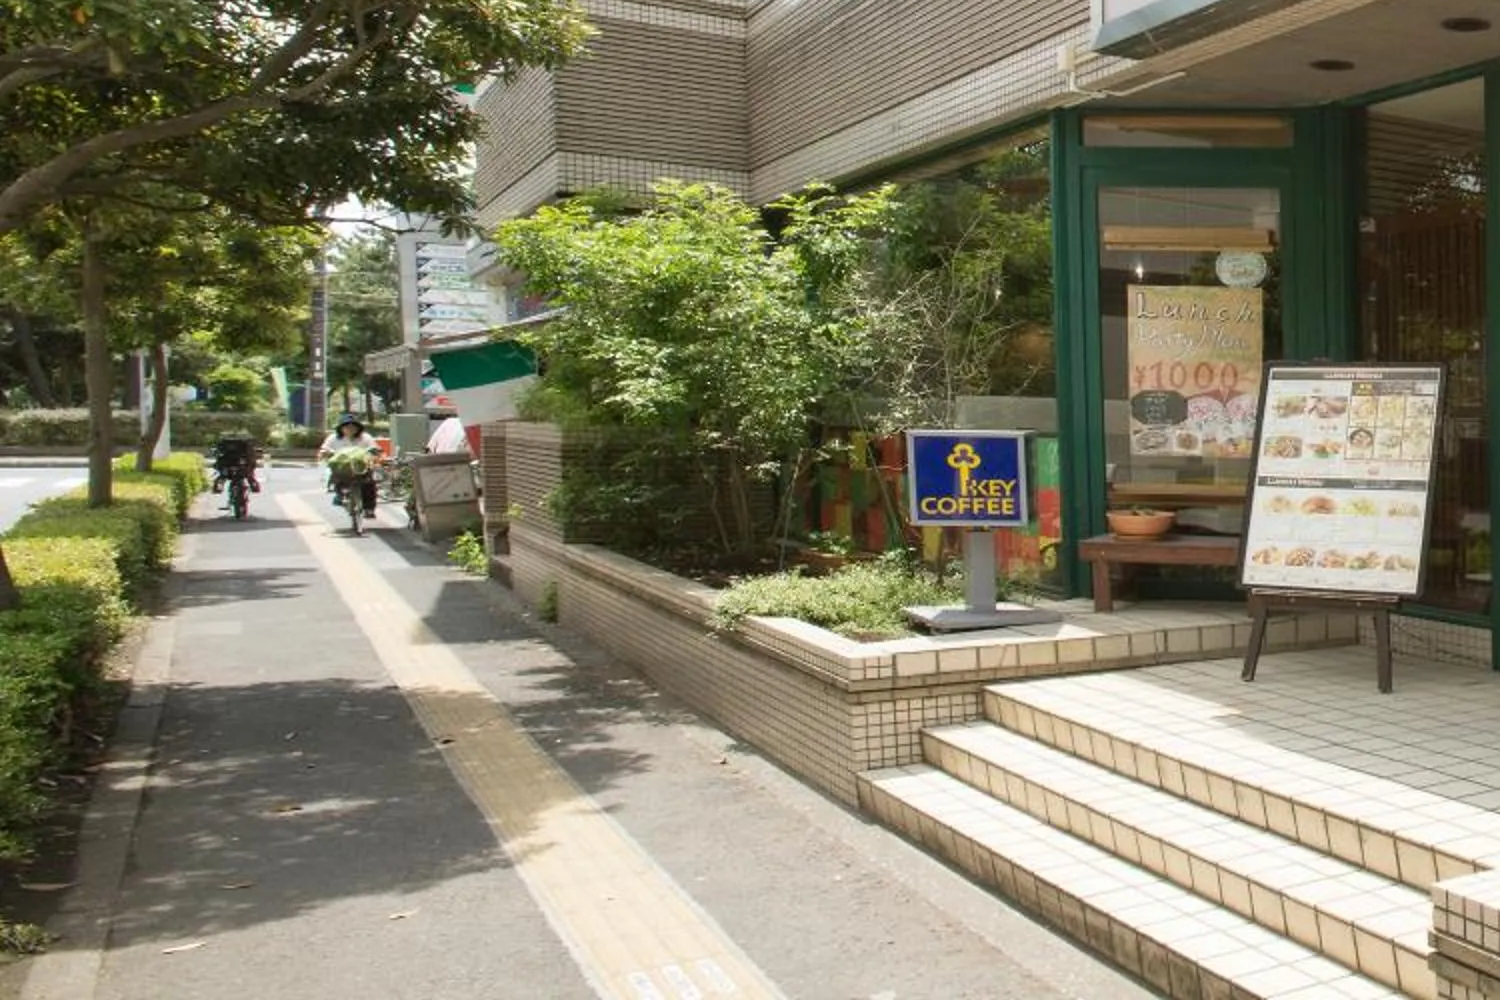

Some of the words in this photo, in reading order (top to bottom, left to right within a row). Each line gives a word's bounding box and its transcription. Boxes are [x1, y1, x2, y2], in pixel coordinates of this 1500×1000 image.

[1135, 291, 1256, 324] Lunch
[972, 479, 1017, 497] KEY
[920, 496, 1015, 515] COFFEE
